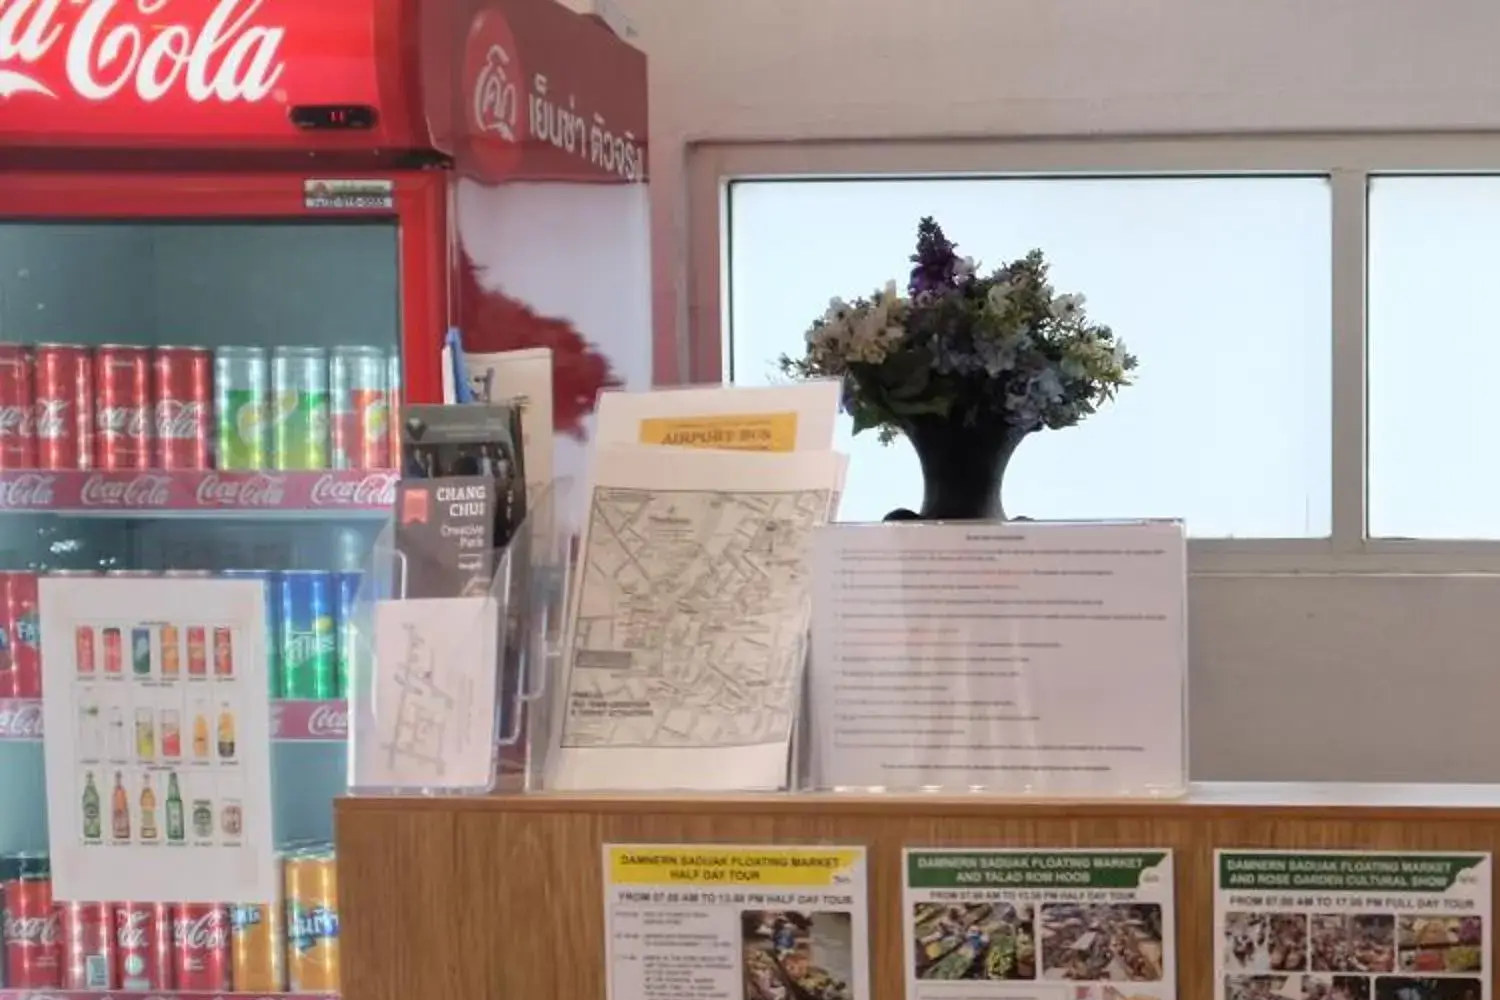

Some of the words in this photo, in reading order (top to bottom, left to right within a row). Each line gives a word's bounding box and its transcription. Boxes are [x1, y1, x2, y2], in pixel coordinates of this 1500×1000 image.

[436, 485, 486, 501] CHANG
[449, 502, 485, 516] CHUI
[703, 869, 725, 881] DAY
[729, 870, 760, 881] TOUR
[1317, 897, 1331, 907] TO
